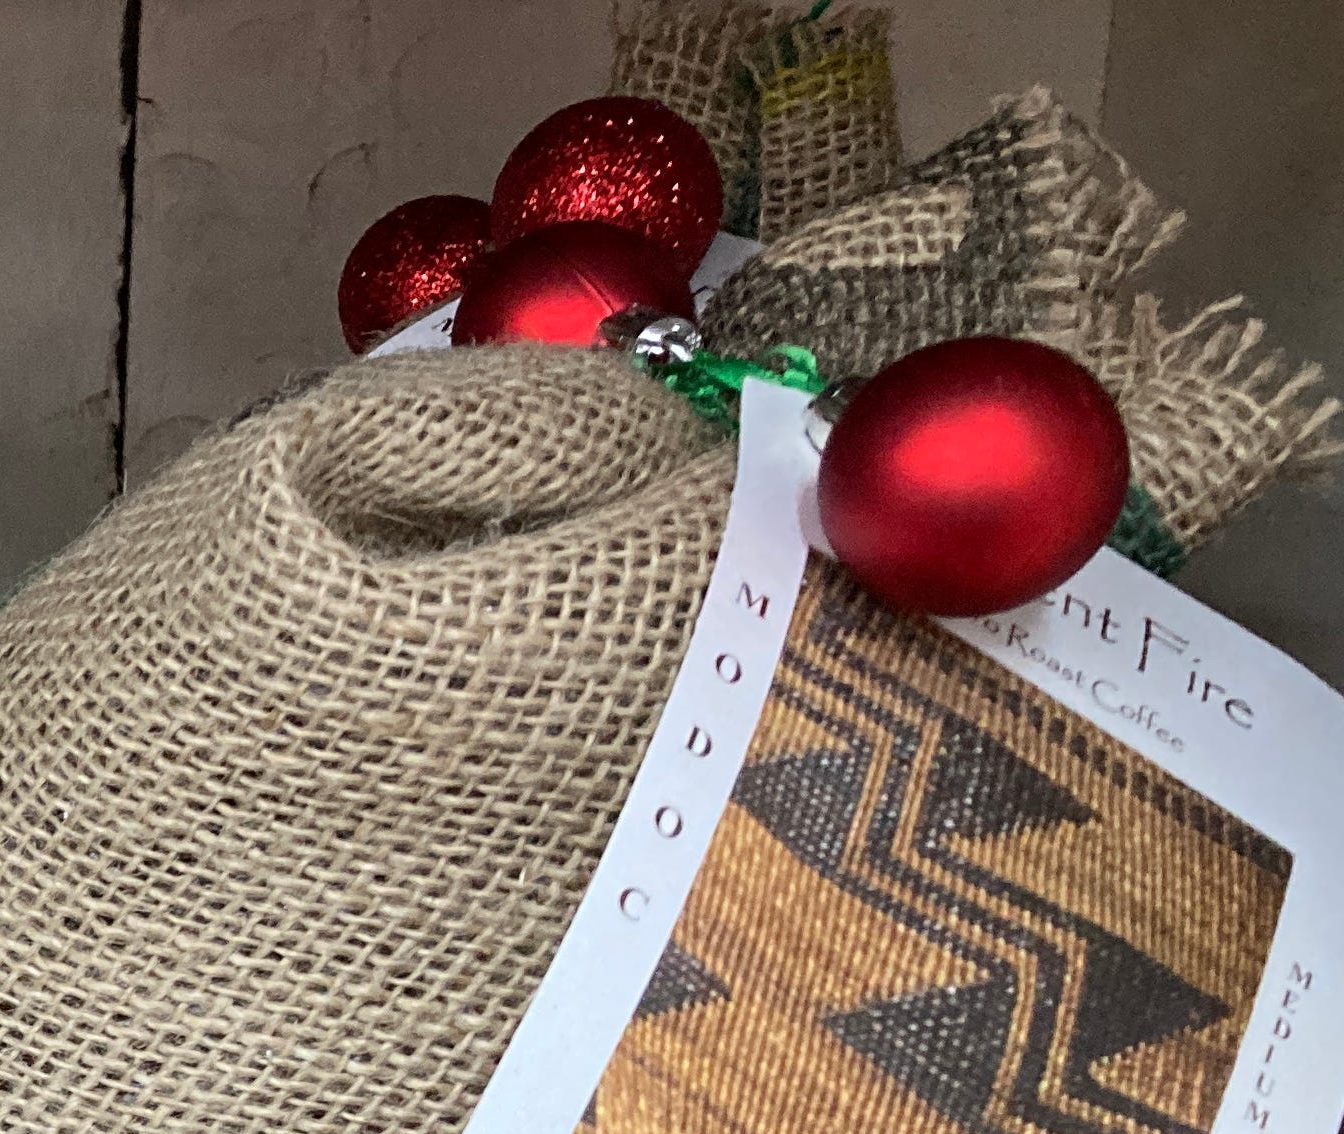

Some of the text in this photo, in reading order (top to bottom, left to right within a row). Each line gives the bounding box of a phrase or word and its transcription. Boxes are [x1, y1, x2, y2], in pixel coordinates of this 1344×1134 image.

[1006, 623, 1186, 753] Roast Coffee
[1138, 616, 1255, 731] Fire
[618, 580, 769, 922] MODOC
[1243, 960, 1313, 1131] MEDIUM
